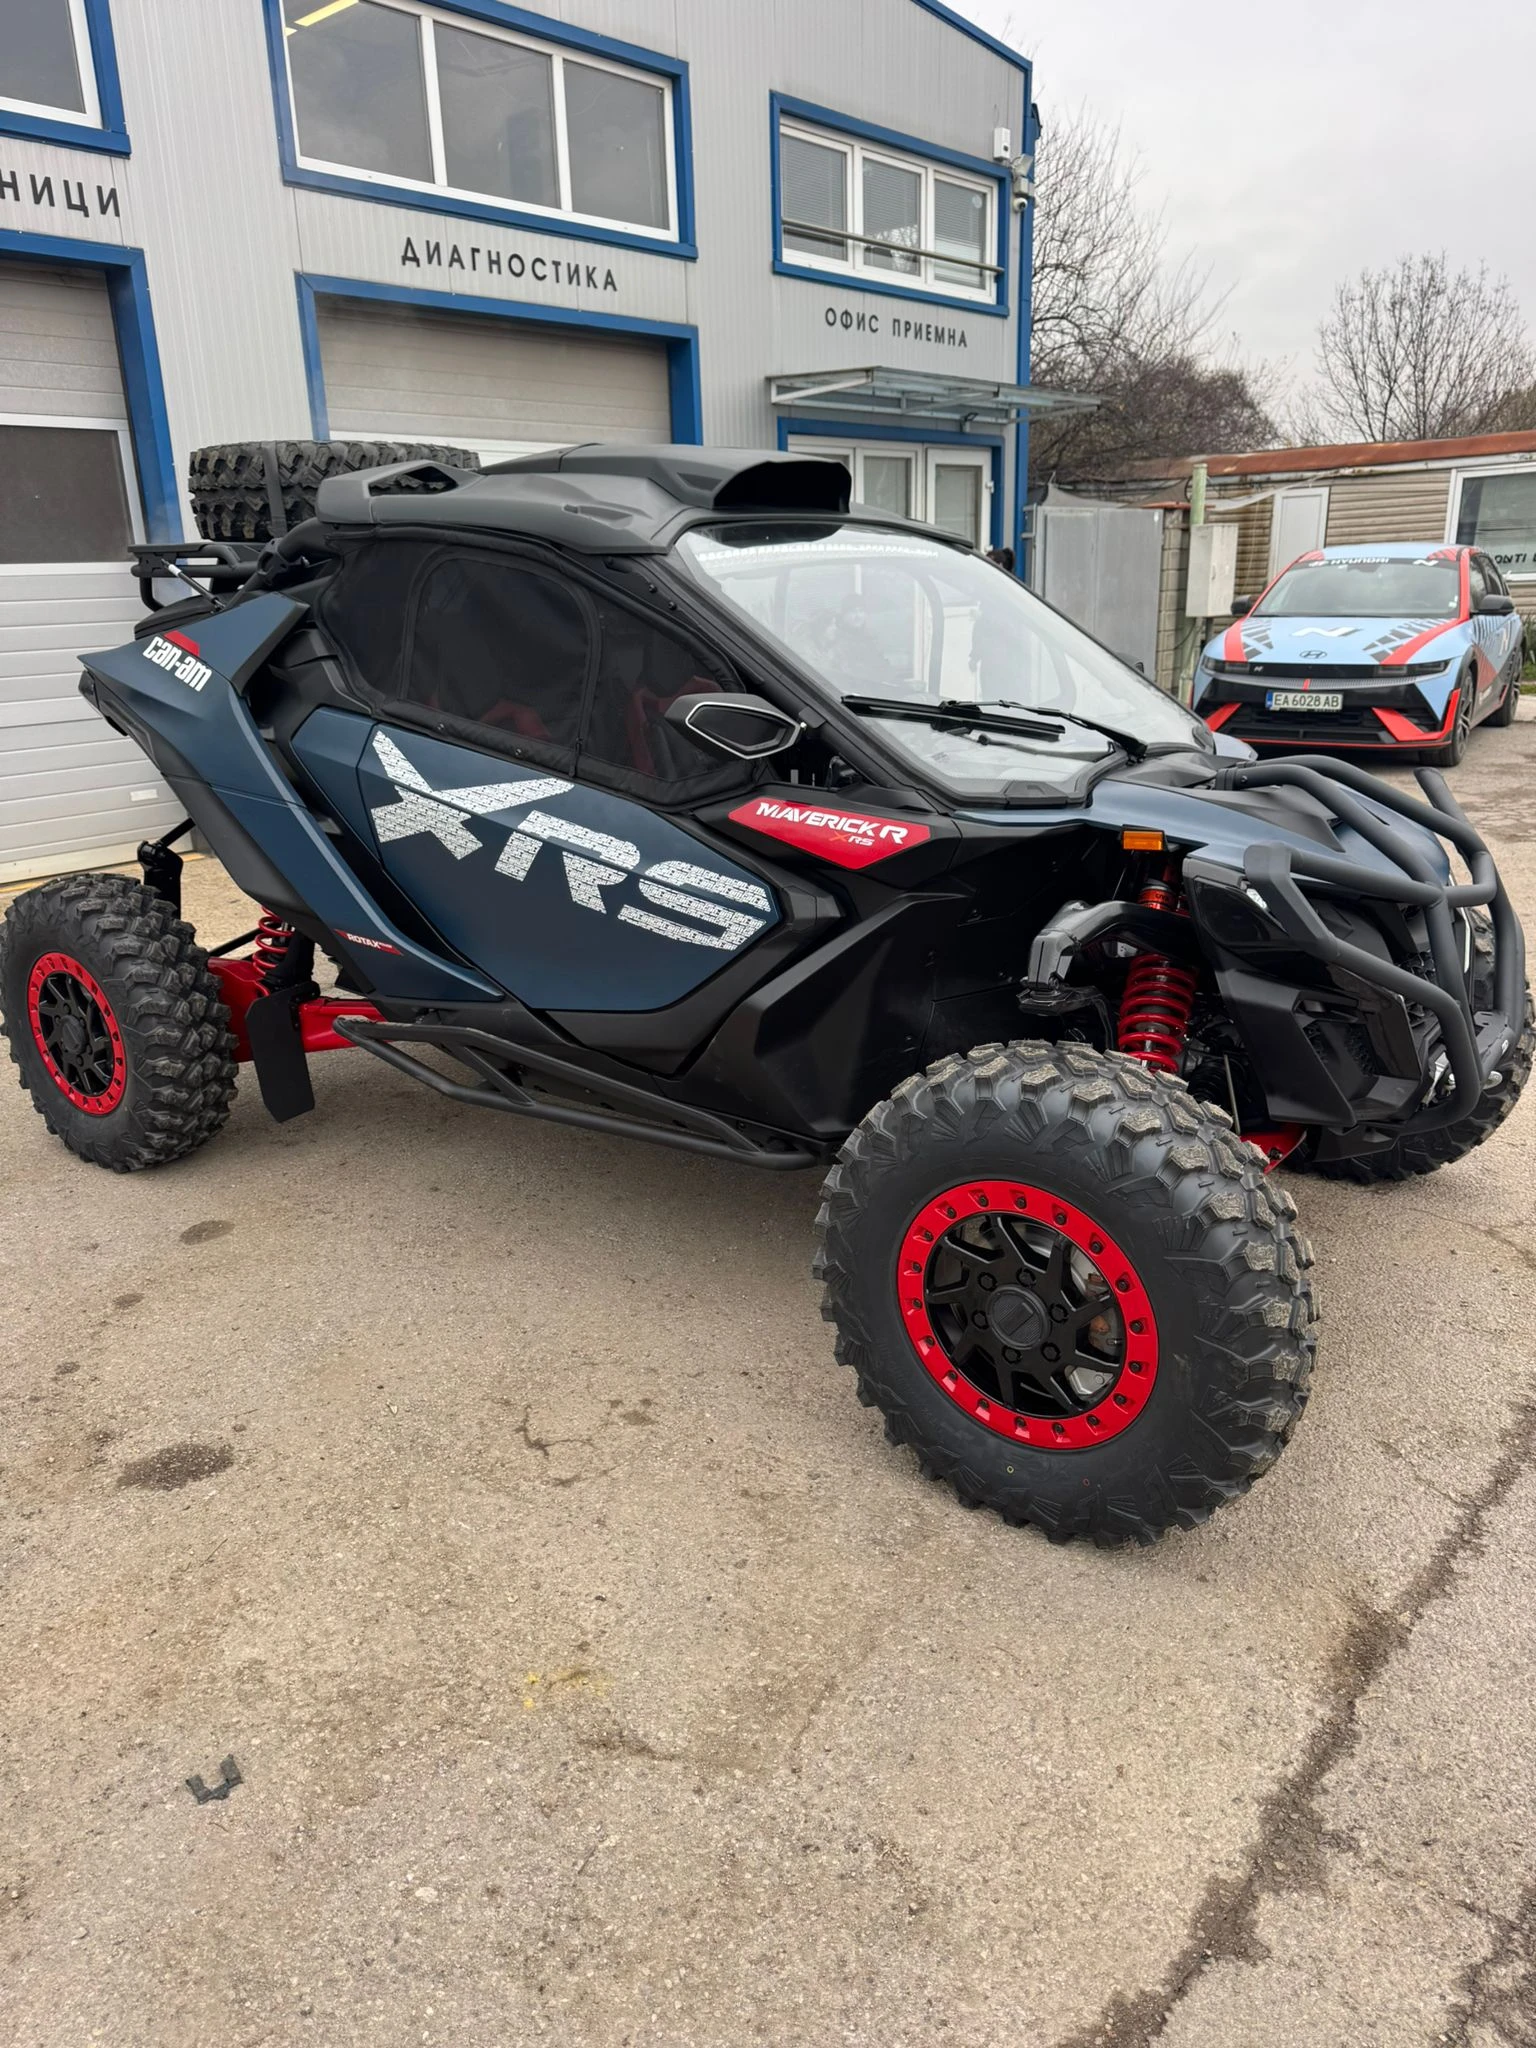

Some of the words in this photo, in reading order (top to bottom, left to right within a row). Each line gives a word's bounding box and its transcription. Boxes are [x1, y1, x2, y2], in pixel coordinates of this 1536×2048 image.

[401, 237, 618, 292] ДИАГНОСТИКА
[825, 307, 879, 333] ОФИС
[892, 318, 968, 348] ПРИЕМНА
[1274, 694, 1292, 706] EA
[1292, 694, 1322, 707] 6028
[1323, 696, 1340, 708] AB
[370, 730, 772, 952] XRS
[756, 802, 881, 837] MAVERICK
[879, 825, 908, 844] R
[347, 932, 381, 949] ROTAX
